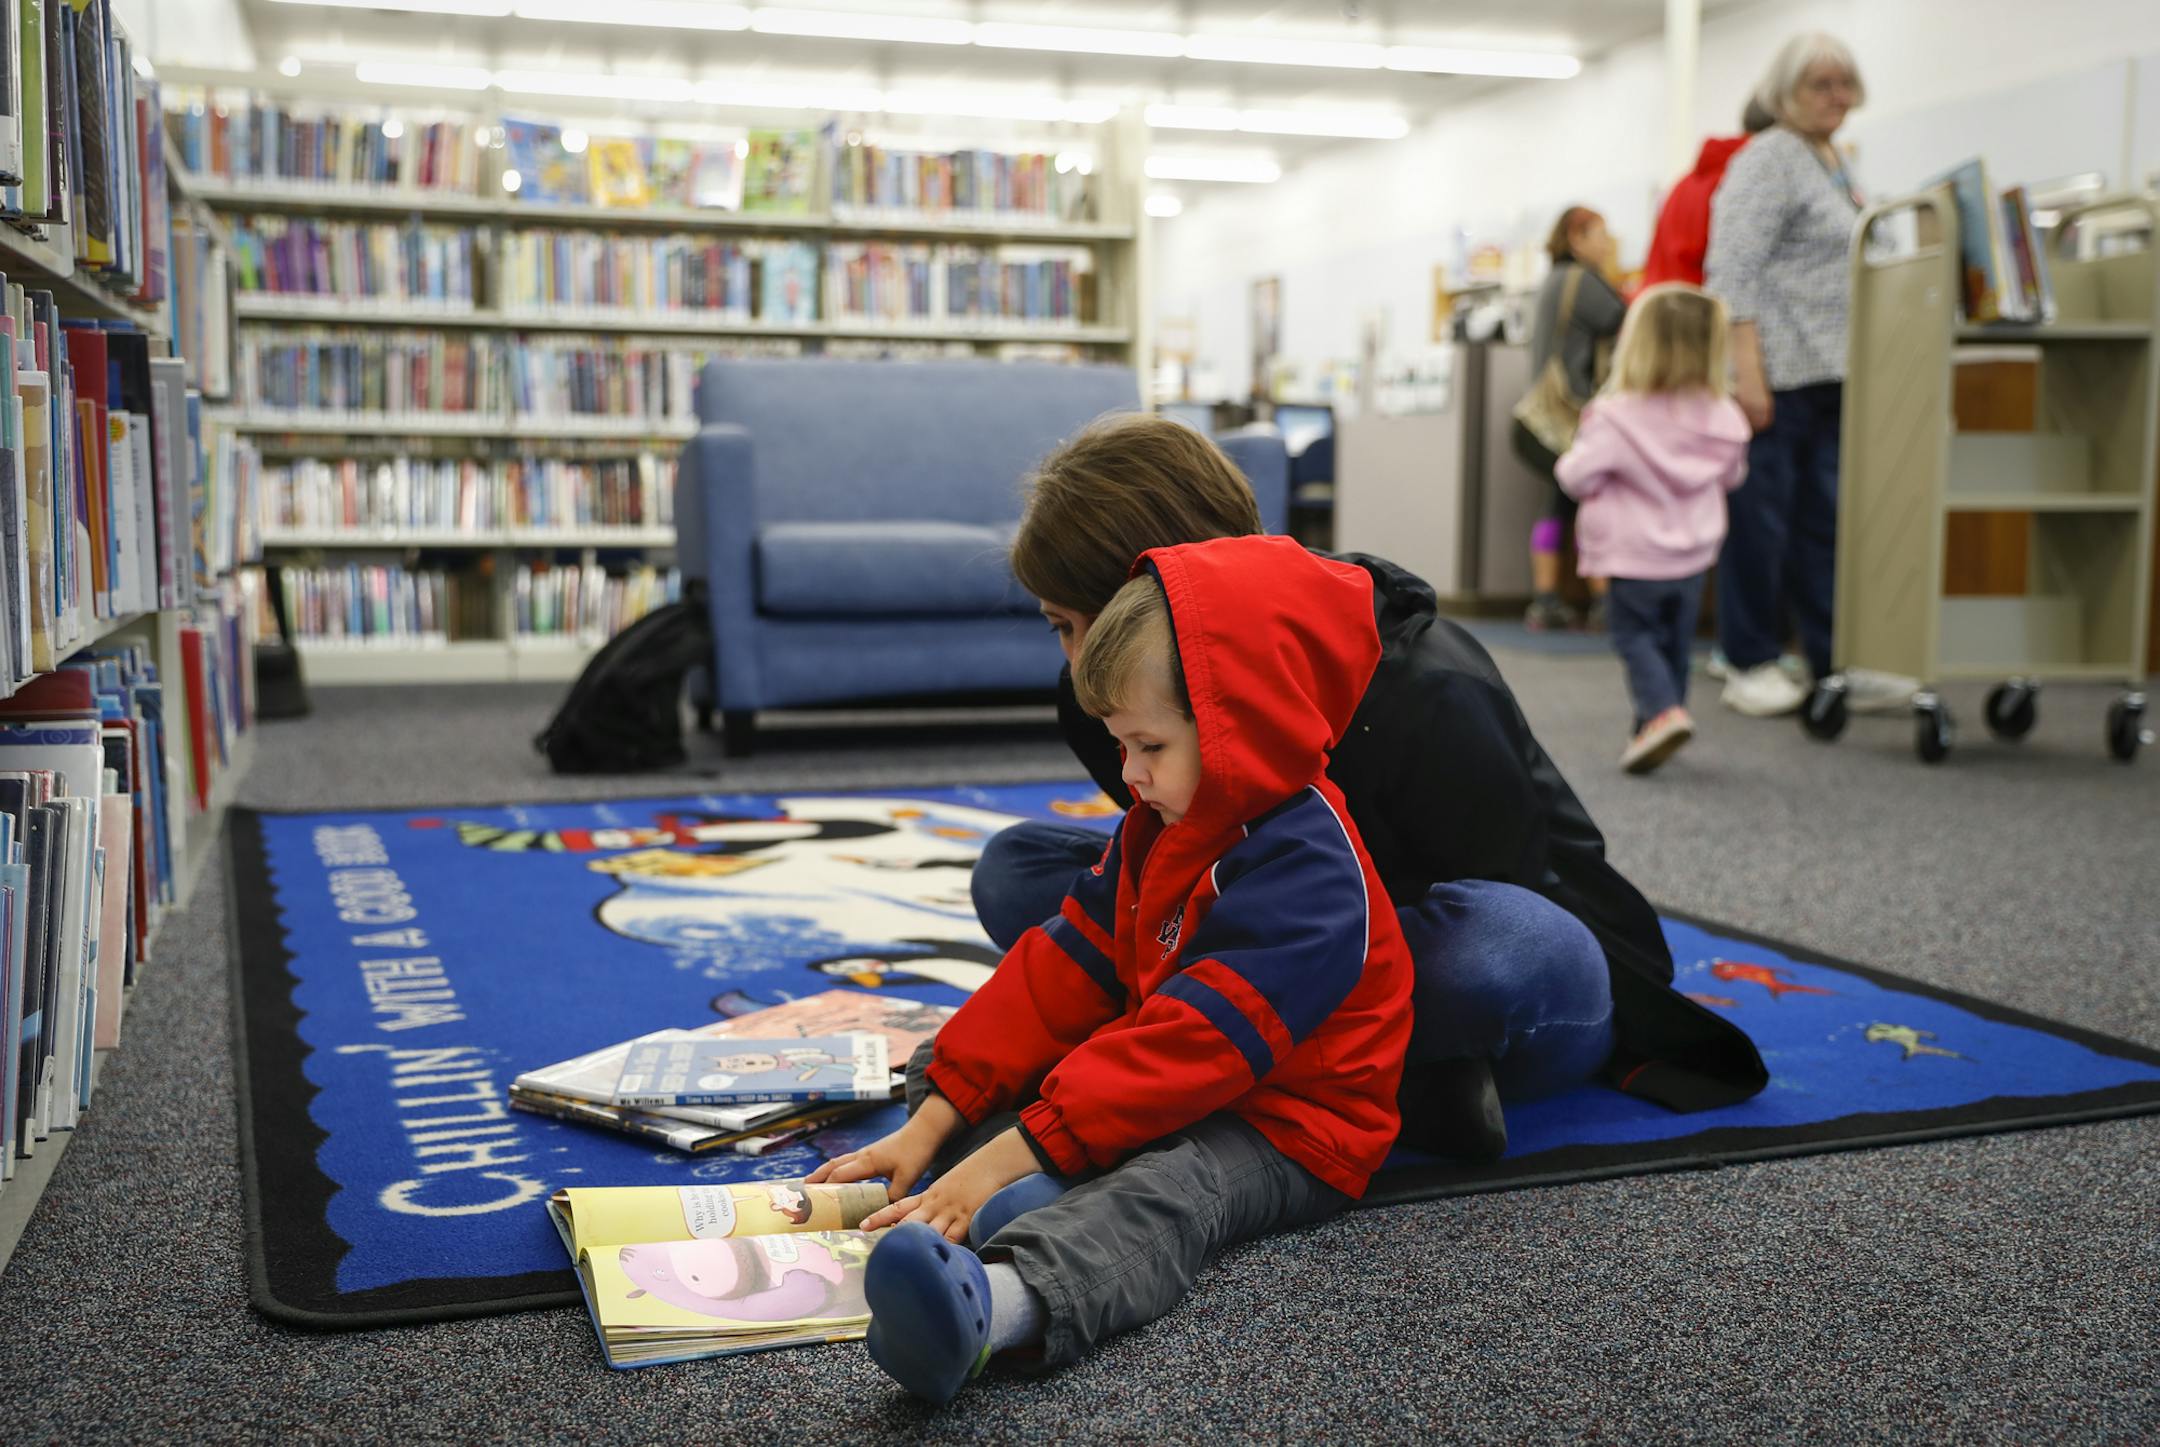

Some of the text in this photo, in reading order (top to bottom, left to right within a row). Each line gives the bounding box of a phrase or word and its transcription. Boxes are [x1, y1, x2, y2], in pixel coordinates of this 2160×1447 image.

[351, 927, 430, 949] A
[359, 957, 466, 1031] WITH
[694, 1208, 705, 1232] Why
[704, 1194, 718, 1224] holding
